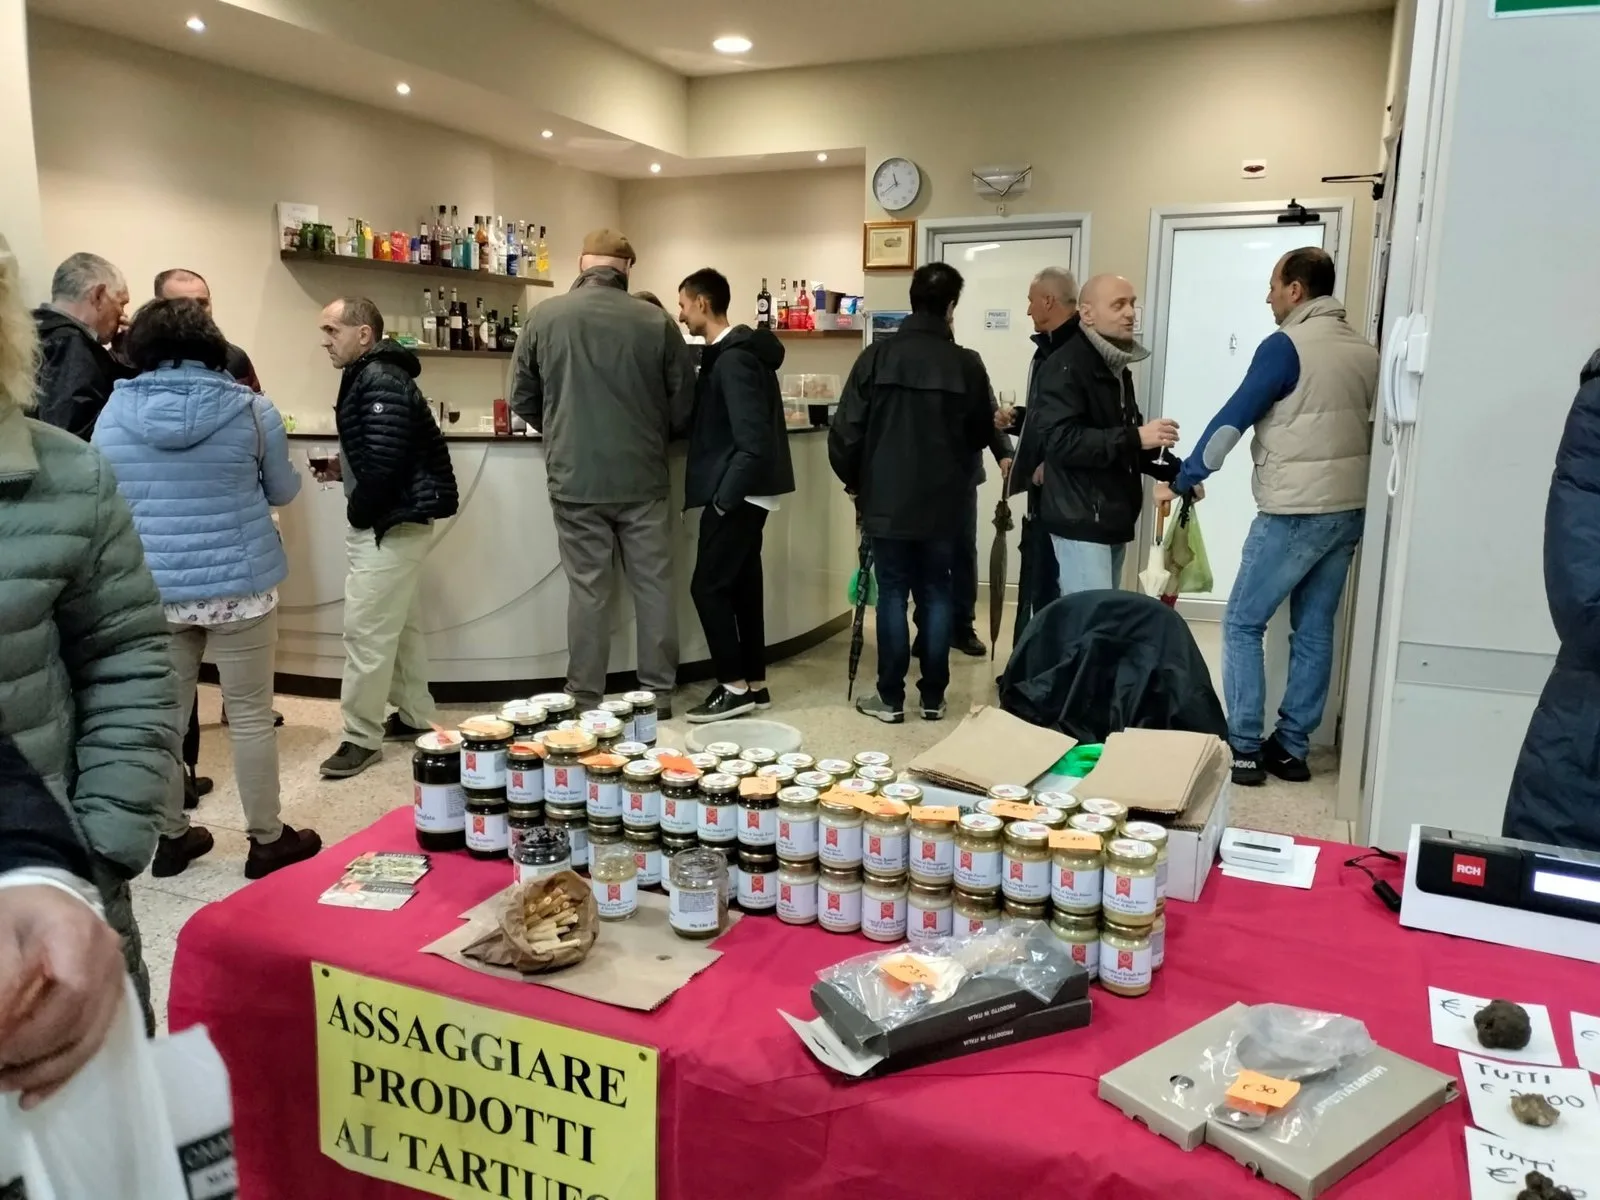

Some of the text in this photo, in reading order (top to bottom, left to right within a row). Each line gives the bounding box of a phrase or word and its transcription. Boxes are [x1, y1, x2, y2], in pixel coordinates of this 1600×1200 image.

[1456, 863, 1481, 876] RCH
[990, 1002, 1017, 1015] PRODOTTO
[967, 1012, 984, 1022] ITALIA
[987, 1029, 1014, 1040] PRODOTTO
[963, 1036, 979, 1047] ITALIA
[327, 994, 628, 1109] ASSAGGIARE
[1474, 1061, 1551, 1085] TUTTI
[1256, 1084, 1277, 1095] 30
[351, 1060, 597, 1165] PRODOTTI
[334, 1117, 612, 1200] AL TARTUF
[1486, 1166, 1517, 1185] €
